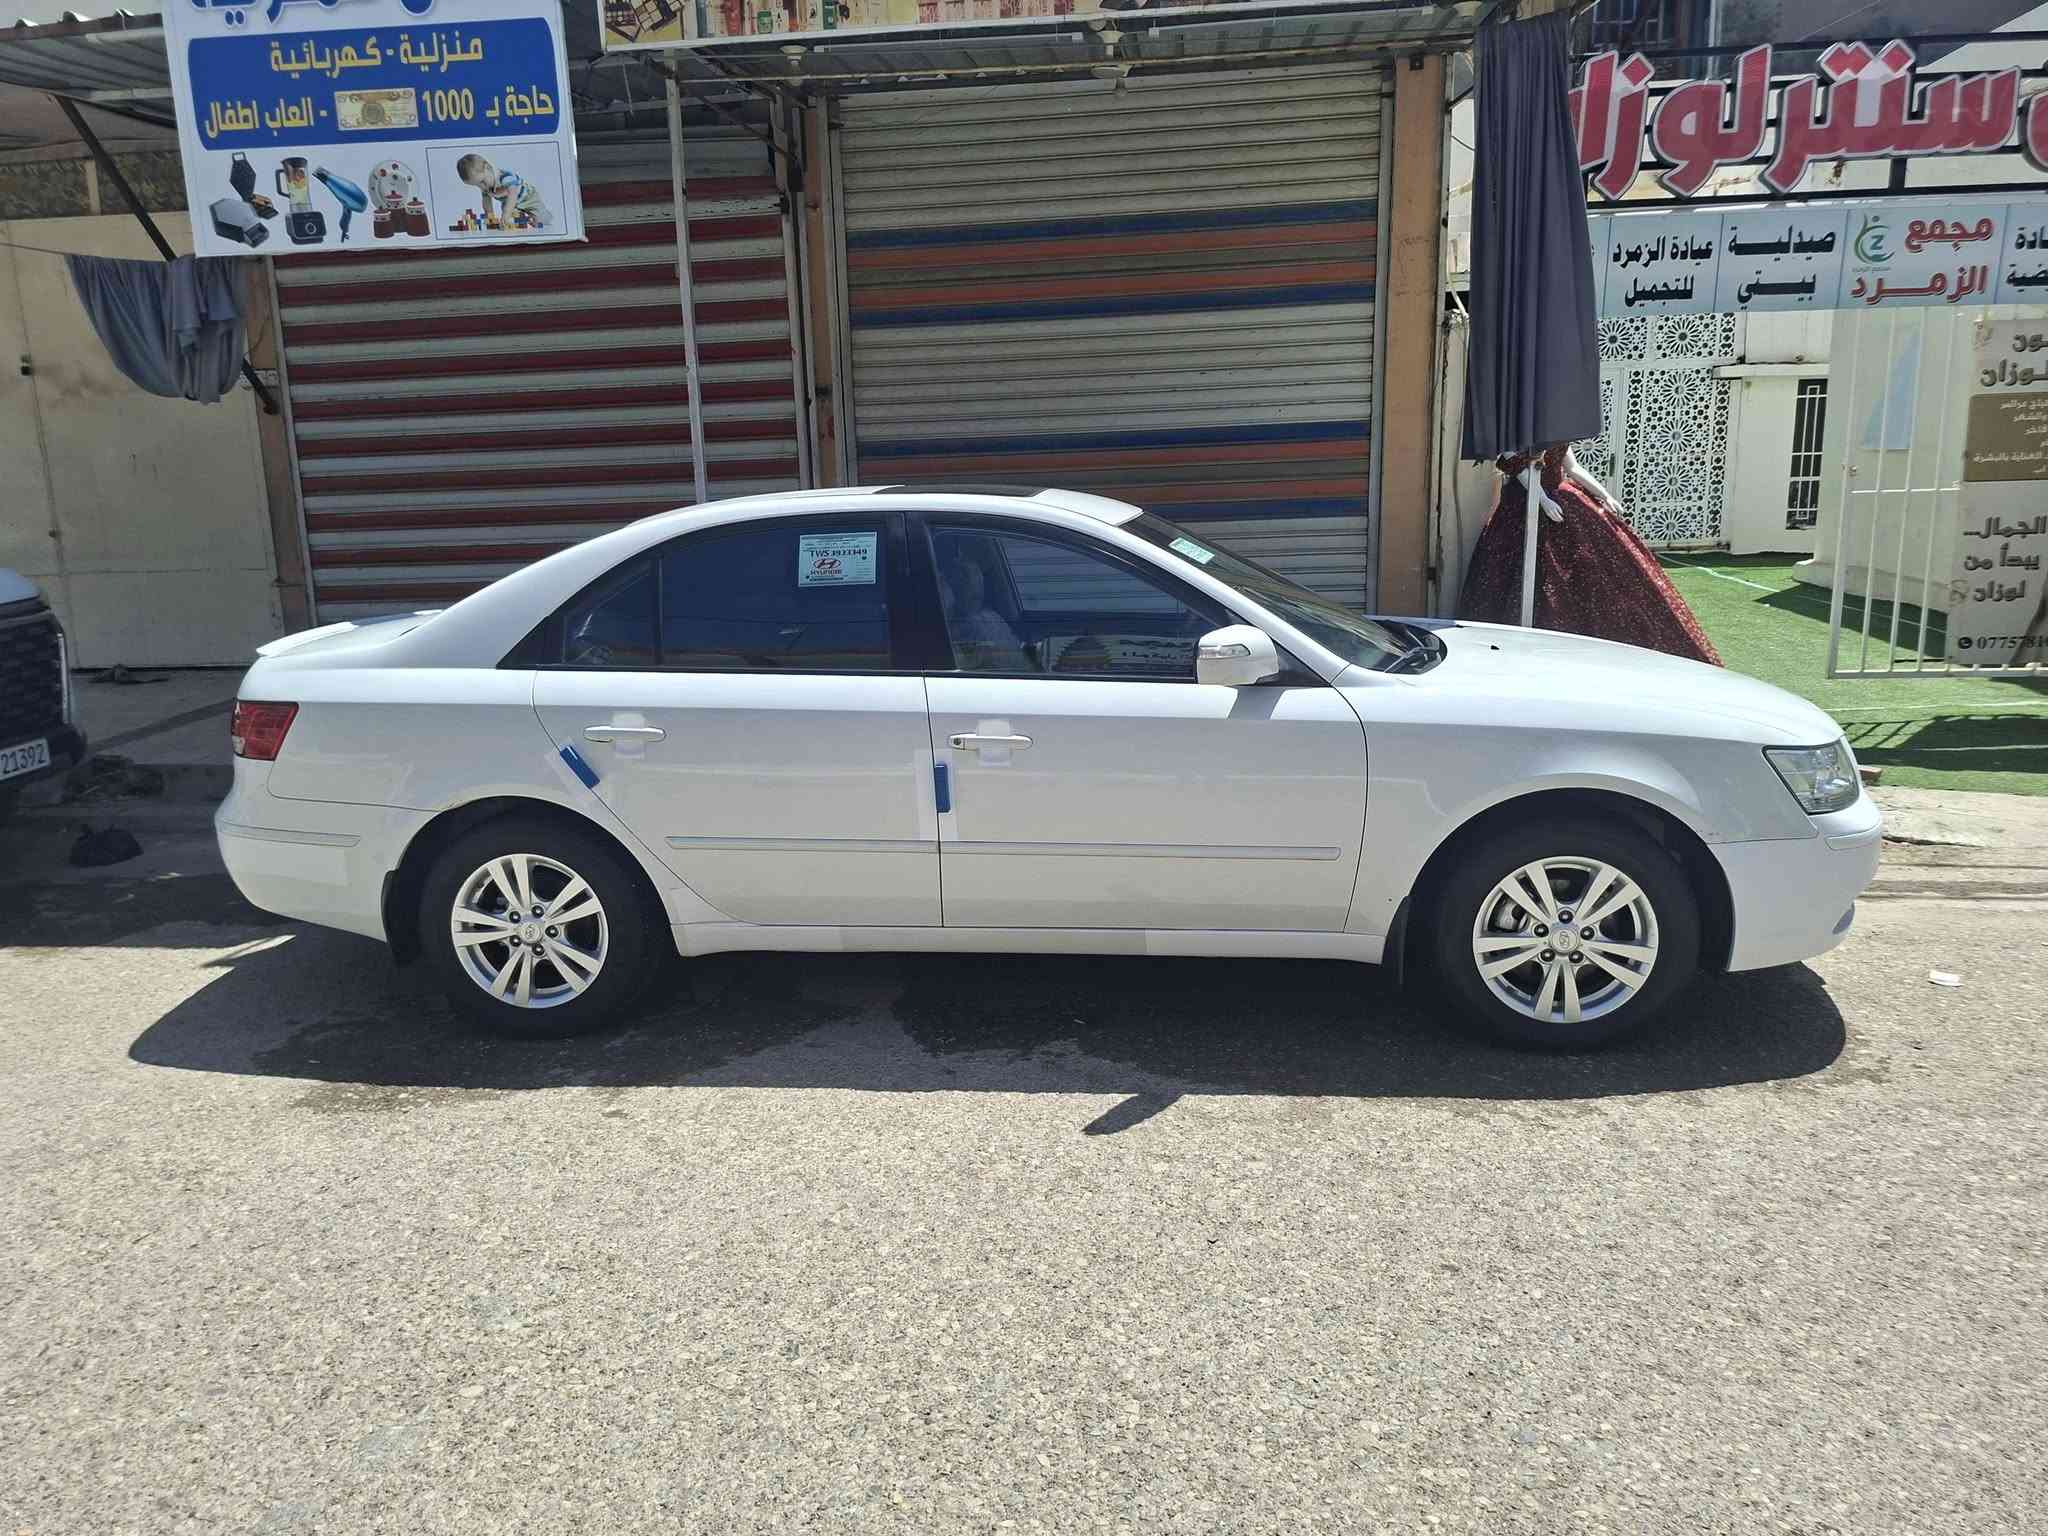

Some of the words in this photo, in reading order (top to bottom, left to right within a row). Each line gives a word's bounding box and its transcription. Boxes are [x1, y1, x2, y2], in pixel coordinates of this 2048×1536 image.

[270, 36, 383, 79] كهربائية
[400, 30, 483, 73] منزلية
[204, 99, 259, 138] اطفال
[264, 97, 314, 137] العاب
[422, 87, 474, 122] 1000
[504, 84, 554, 125] حاجة
[1612, 234, 1668, 269] الزمرد
[1669, 233, 1713, 266] عيادة
[1728, 224, 1836, 262] صيدلية
[1903, 217, 1993, 253] مجمع
[2014, 225, 2048, 250] ادة
[1624, 275, 1695, 308] للتجميل
[1737, 269, 1817, 311] بيتي
[1850, 264, 1989, 305] الزمرد
[1964, 555, 1993, 571] من
[1999, 542, 2040, 570] يبدأ
[1, 744, 46, 774] 21392
